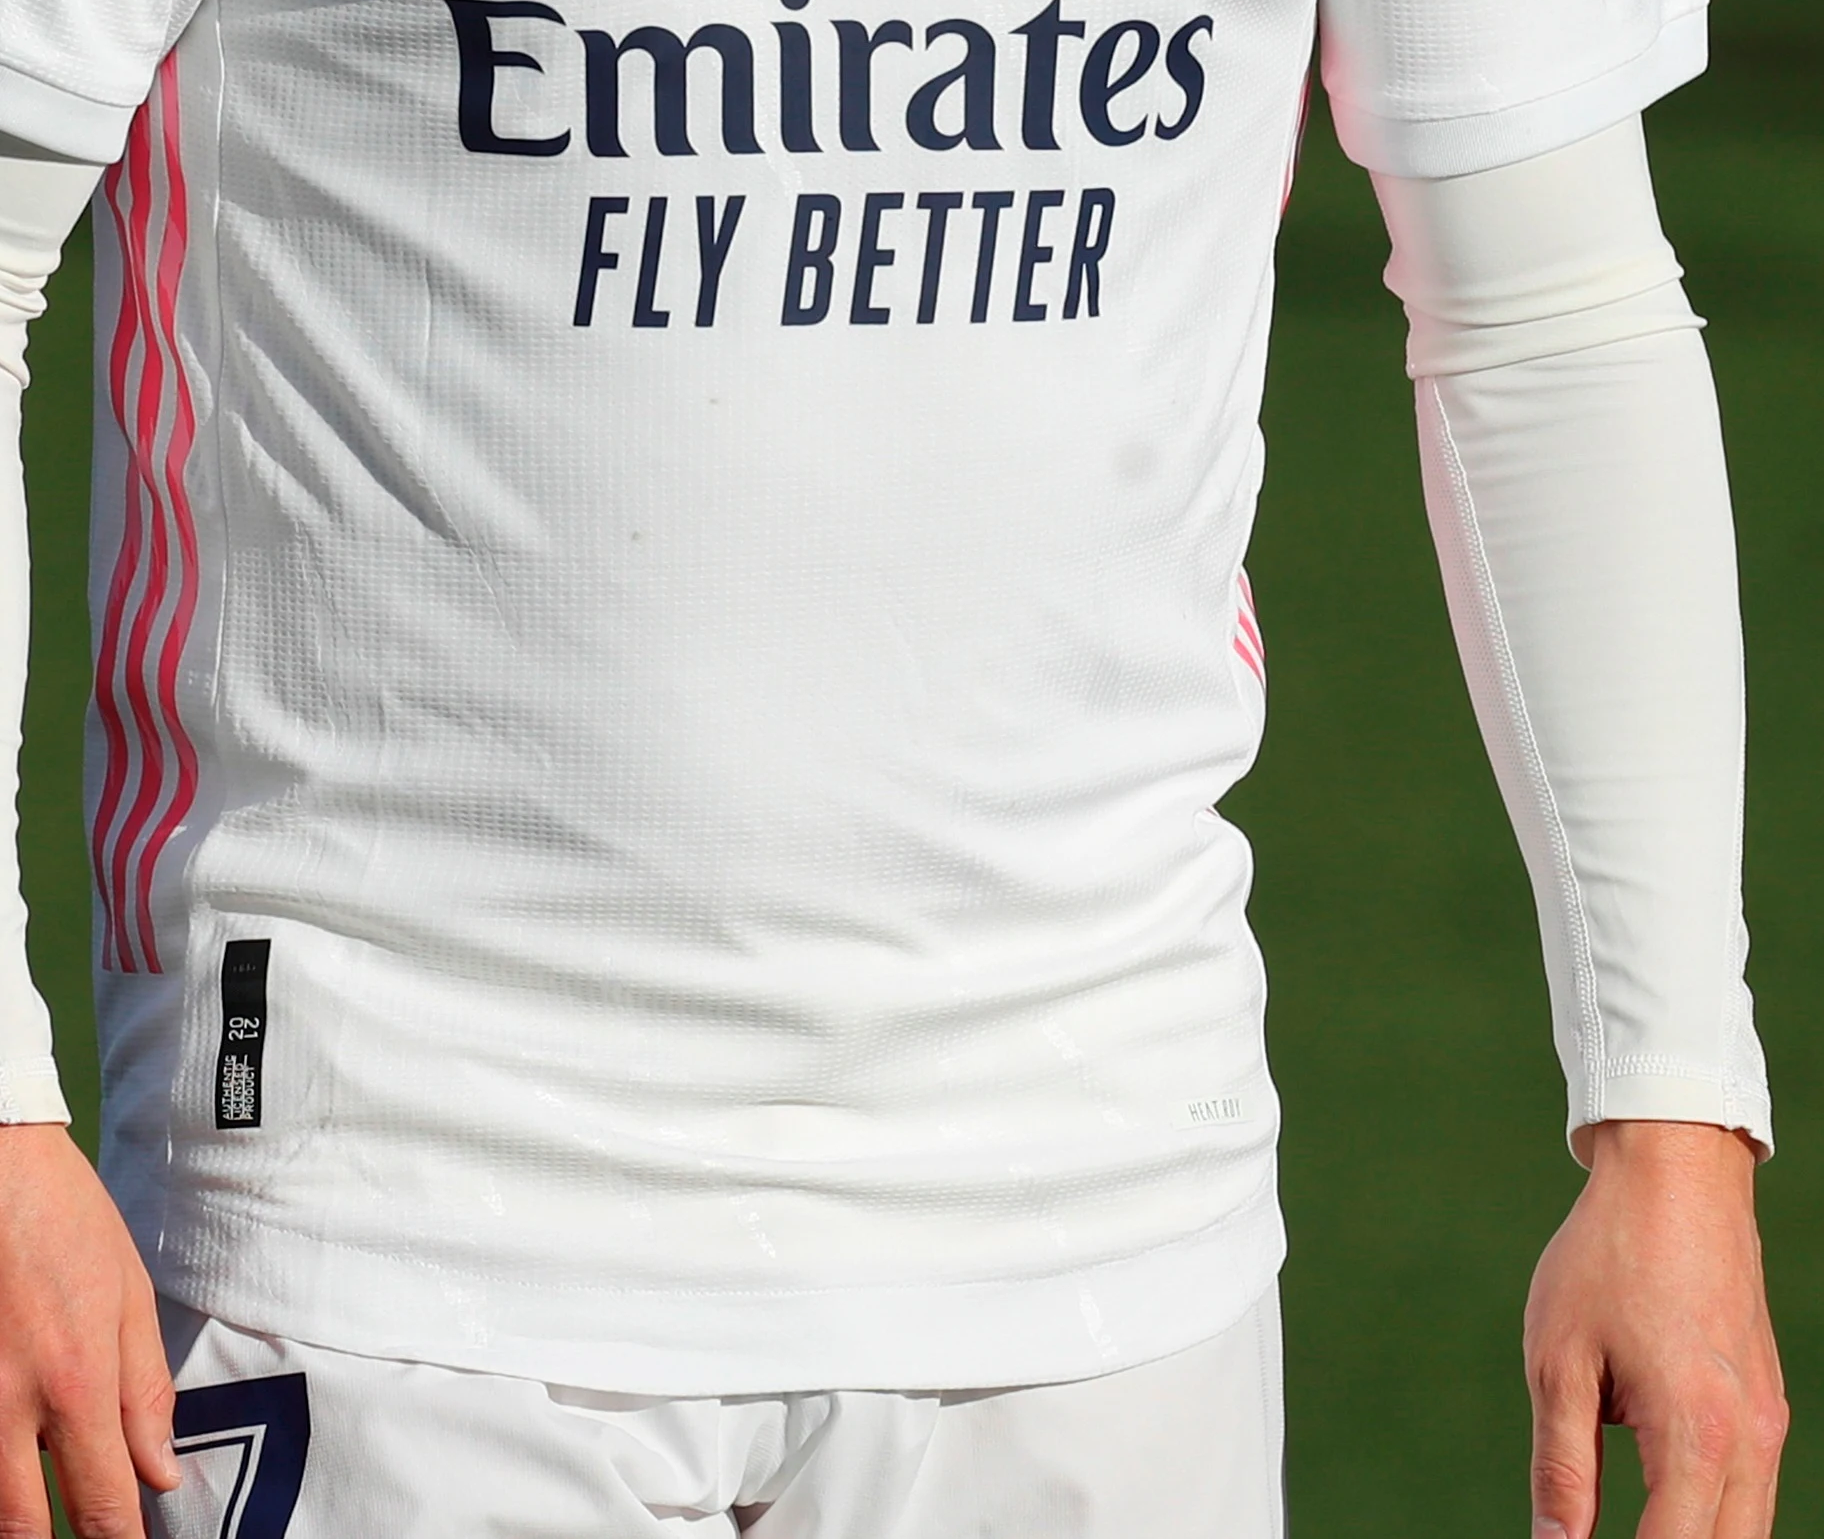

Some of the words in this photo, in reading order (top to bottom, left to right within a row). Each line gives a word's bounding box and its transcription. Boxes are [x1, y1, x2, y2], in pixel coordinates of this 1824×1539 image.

[572, 195, 746, 328] FLY
[780, 187, 1116, 327] BETTER
[228, 1016, 244, 1041] 20
[221, 1054, 236, 1121] AUTHENTIC
[232, 1062, 244, 1121] LICENSED
[242, 1065, 255, 1121] PRODUCT
[172, 1372, 311, 1539] 7
